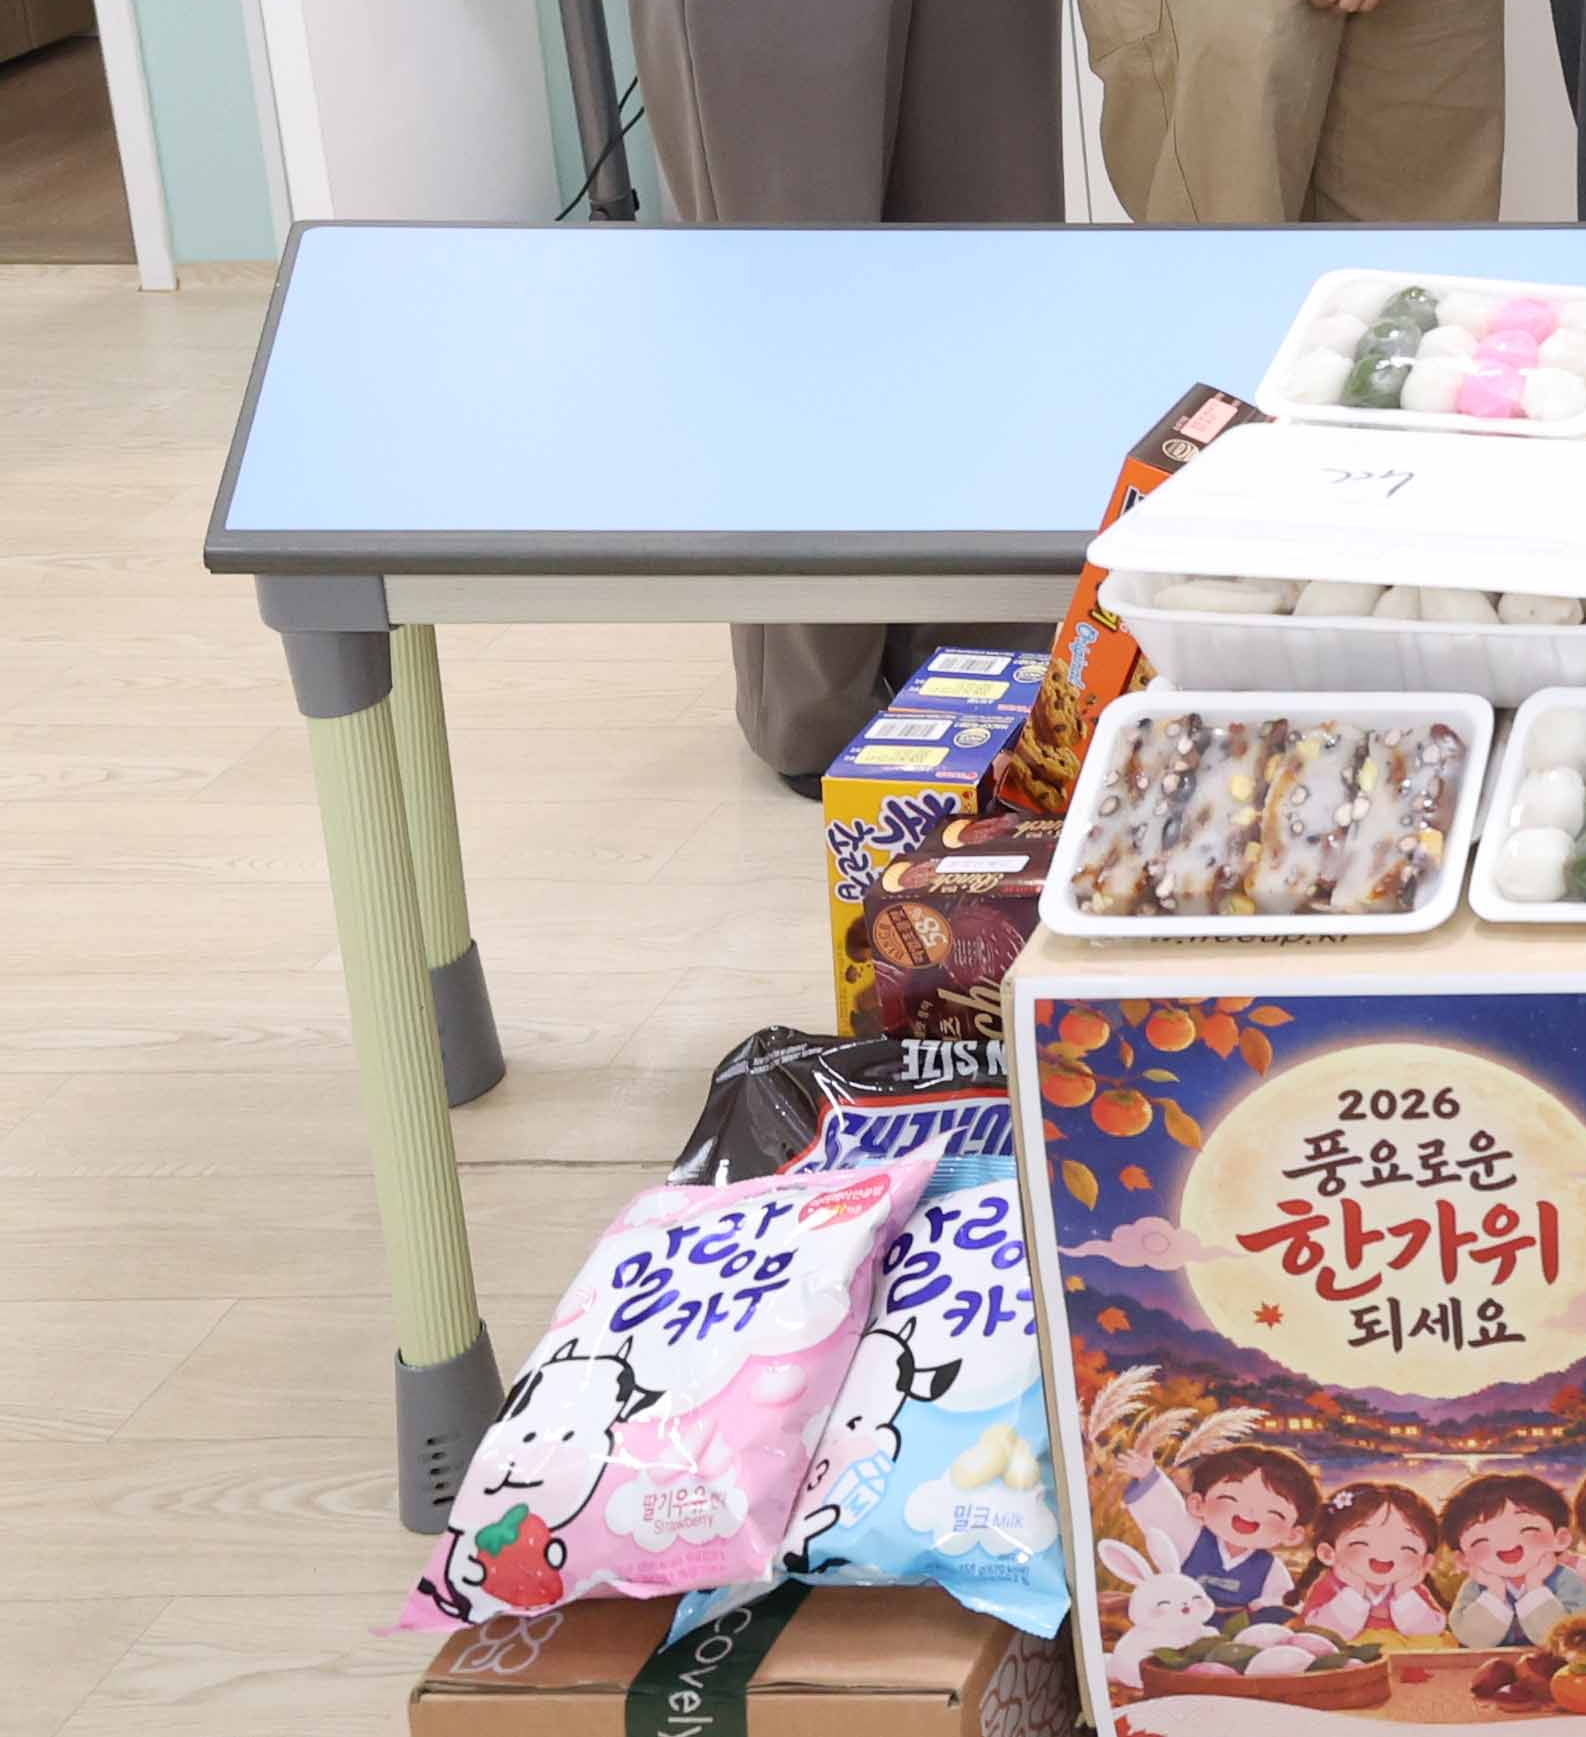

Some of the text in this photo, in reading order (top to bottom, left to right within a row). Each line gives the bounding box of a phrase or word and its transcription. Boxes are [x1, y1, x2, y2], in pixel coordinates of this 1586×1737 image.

[900, 1039, 978, 1082] SIZE
[1337, 1087, 1462, 1122] 2026
[1283, 1129, 1518, 1197] 풍요로운
[610, 1200, 794, 1333] 말랑
[1236, 1198, 1560, 1303] 한가위
[663, 1247, 799, 1346] 카우
[943, 1284, 1037, 1338] 카
[1345, 1297, 1527, 1354] 되세요
[952, 1503, 991, 1533] 밀크
